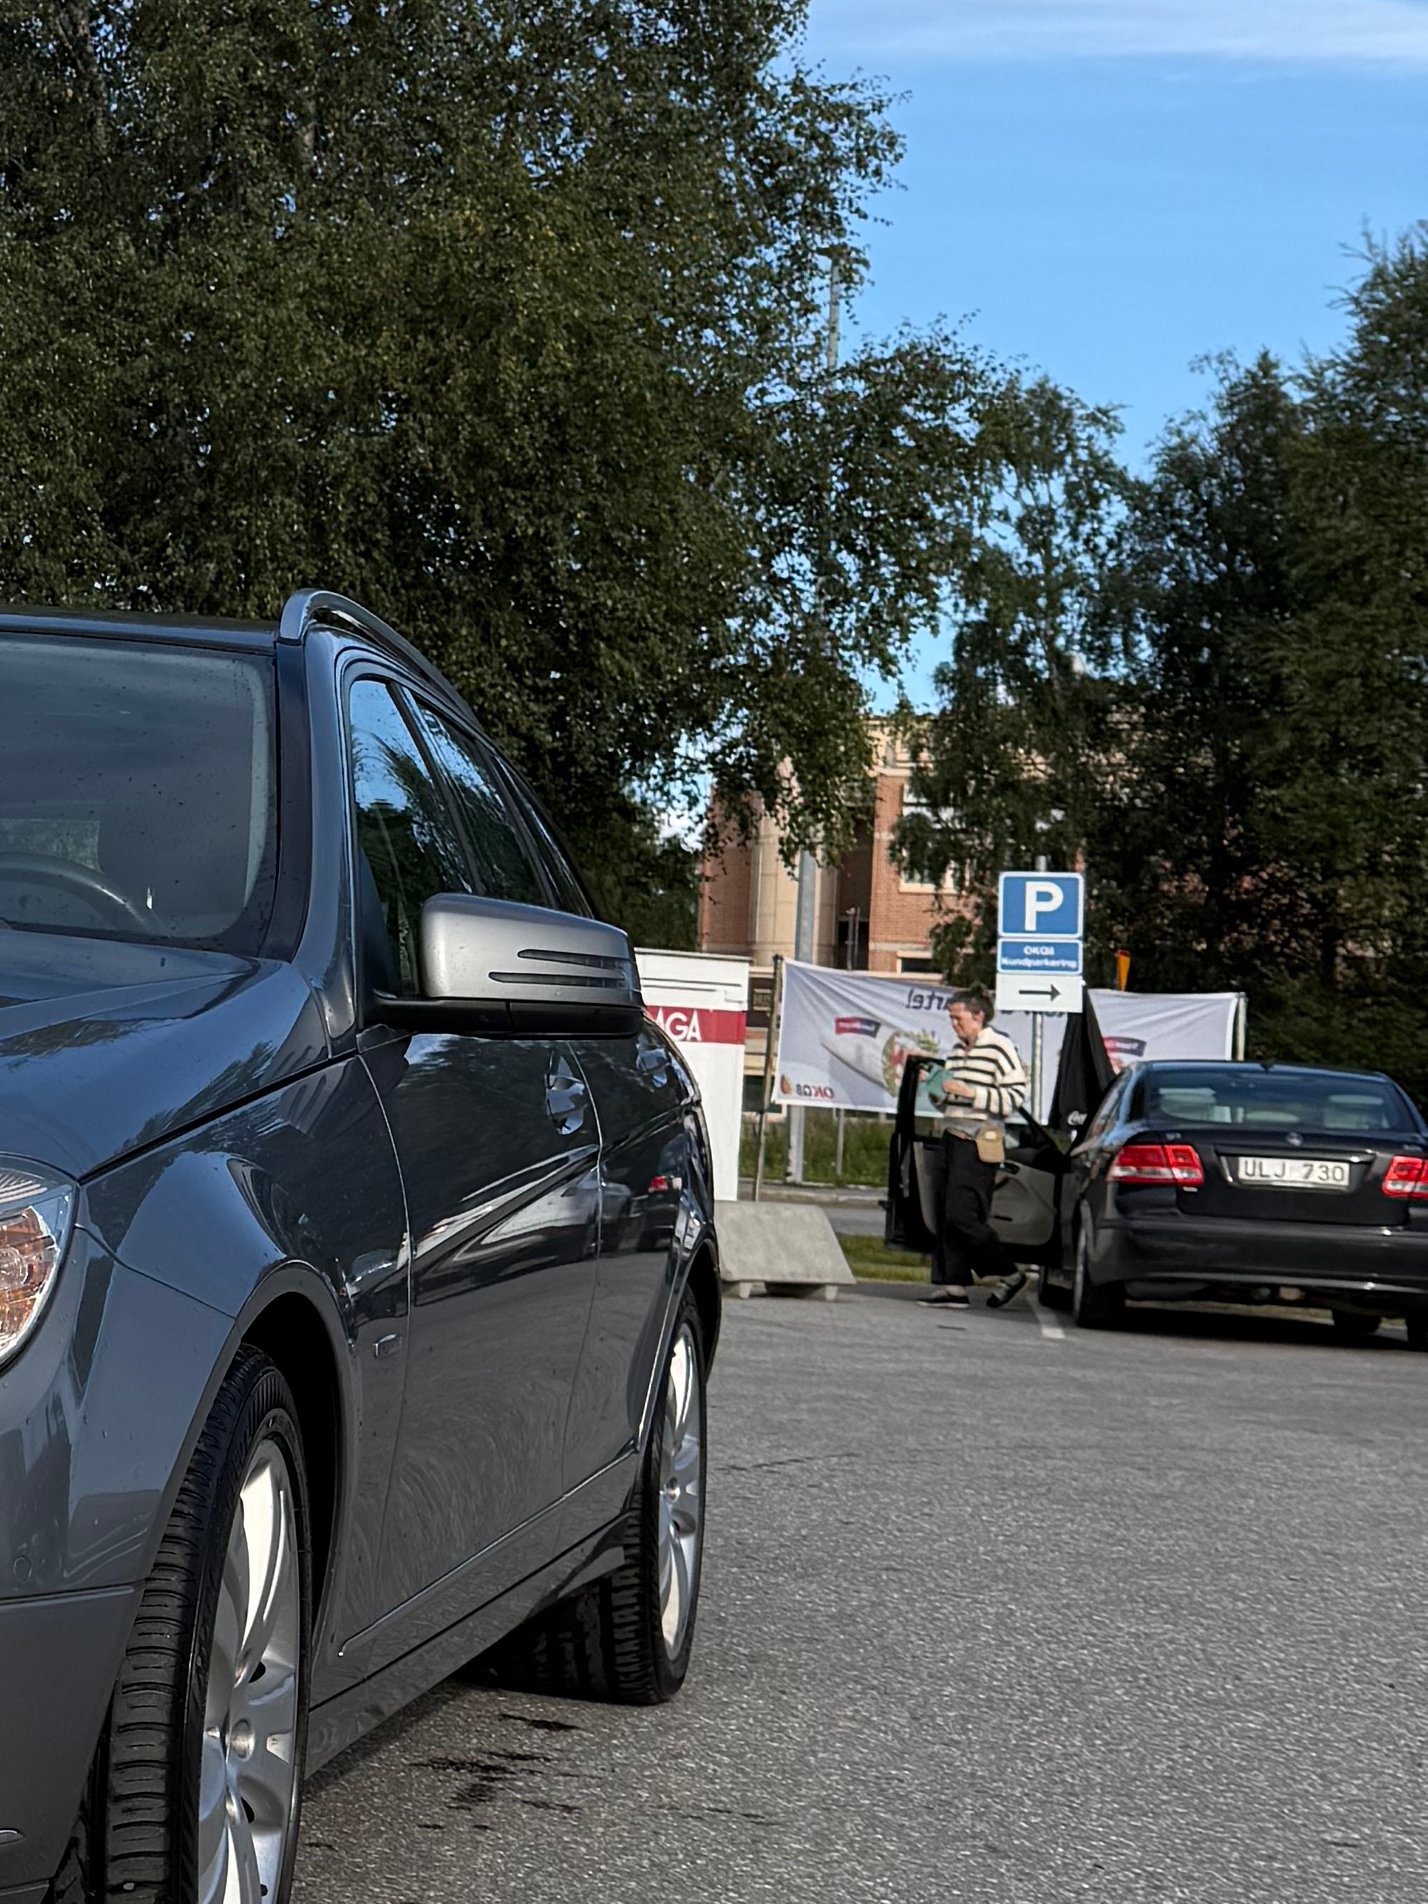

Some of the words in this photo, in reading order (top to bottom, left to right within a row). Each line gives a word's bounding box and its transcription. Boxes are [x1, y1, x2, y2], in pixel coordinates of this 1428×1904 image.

[1024, 881, 1064, 931] P
[1245, 1160, 1286, 1178] ULJ
[1302, 1163, 1344, 1182] 730
